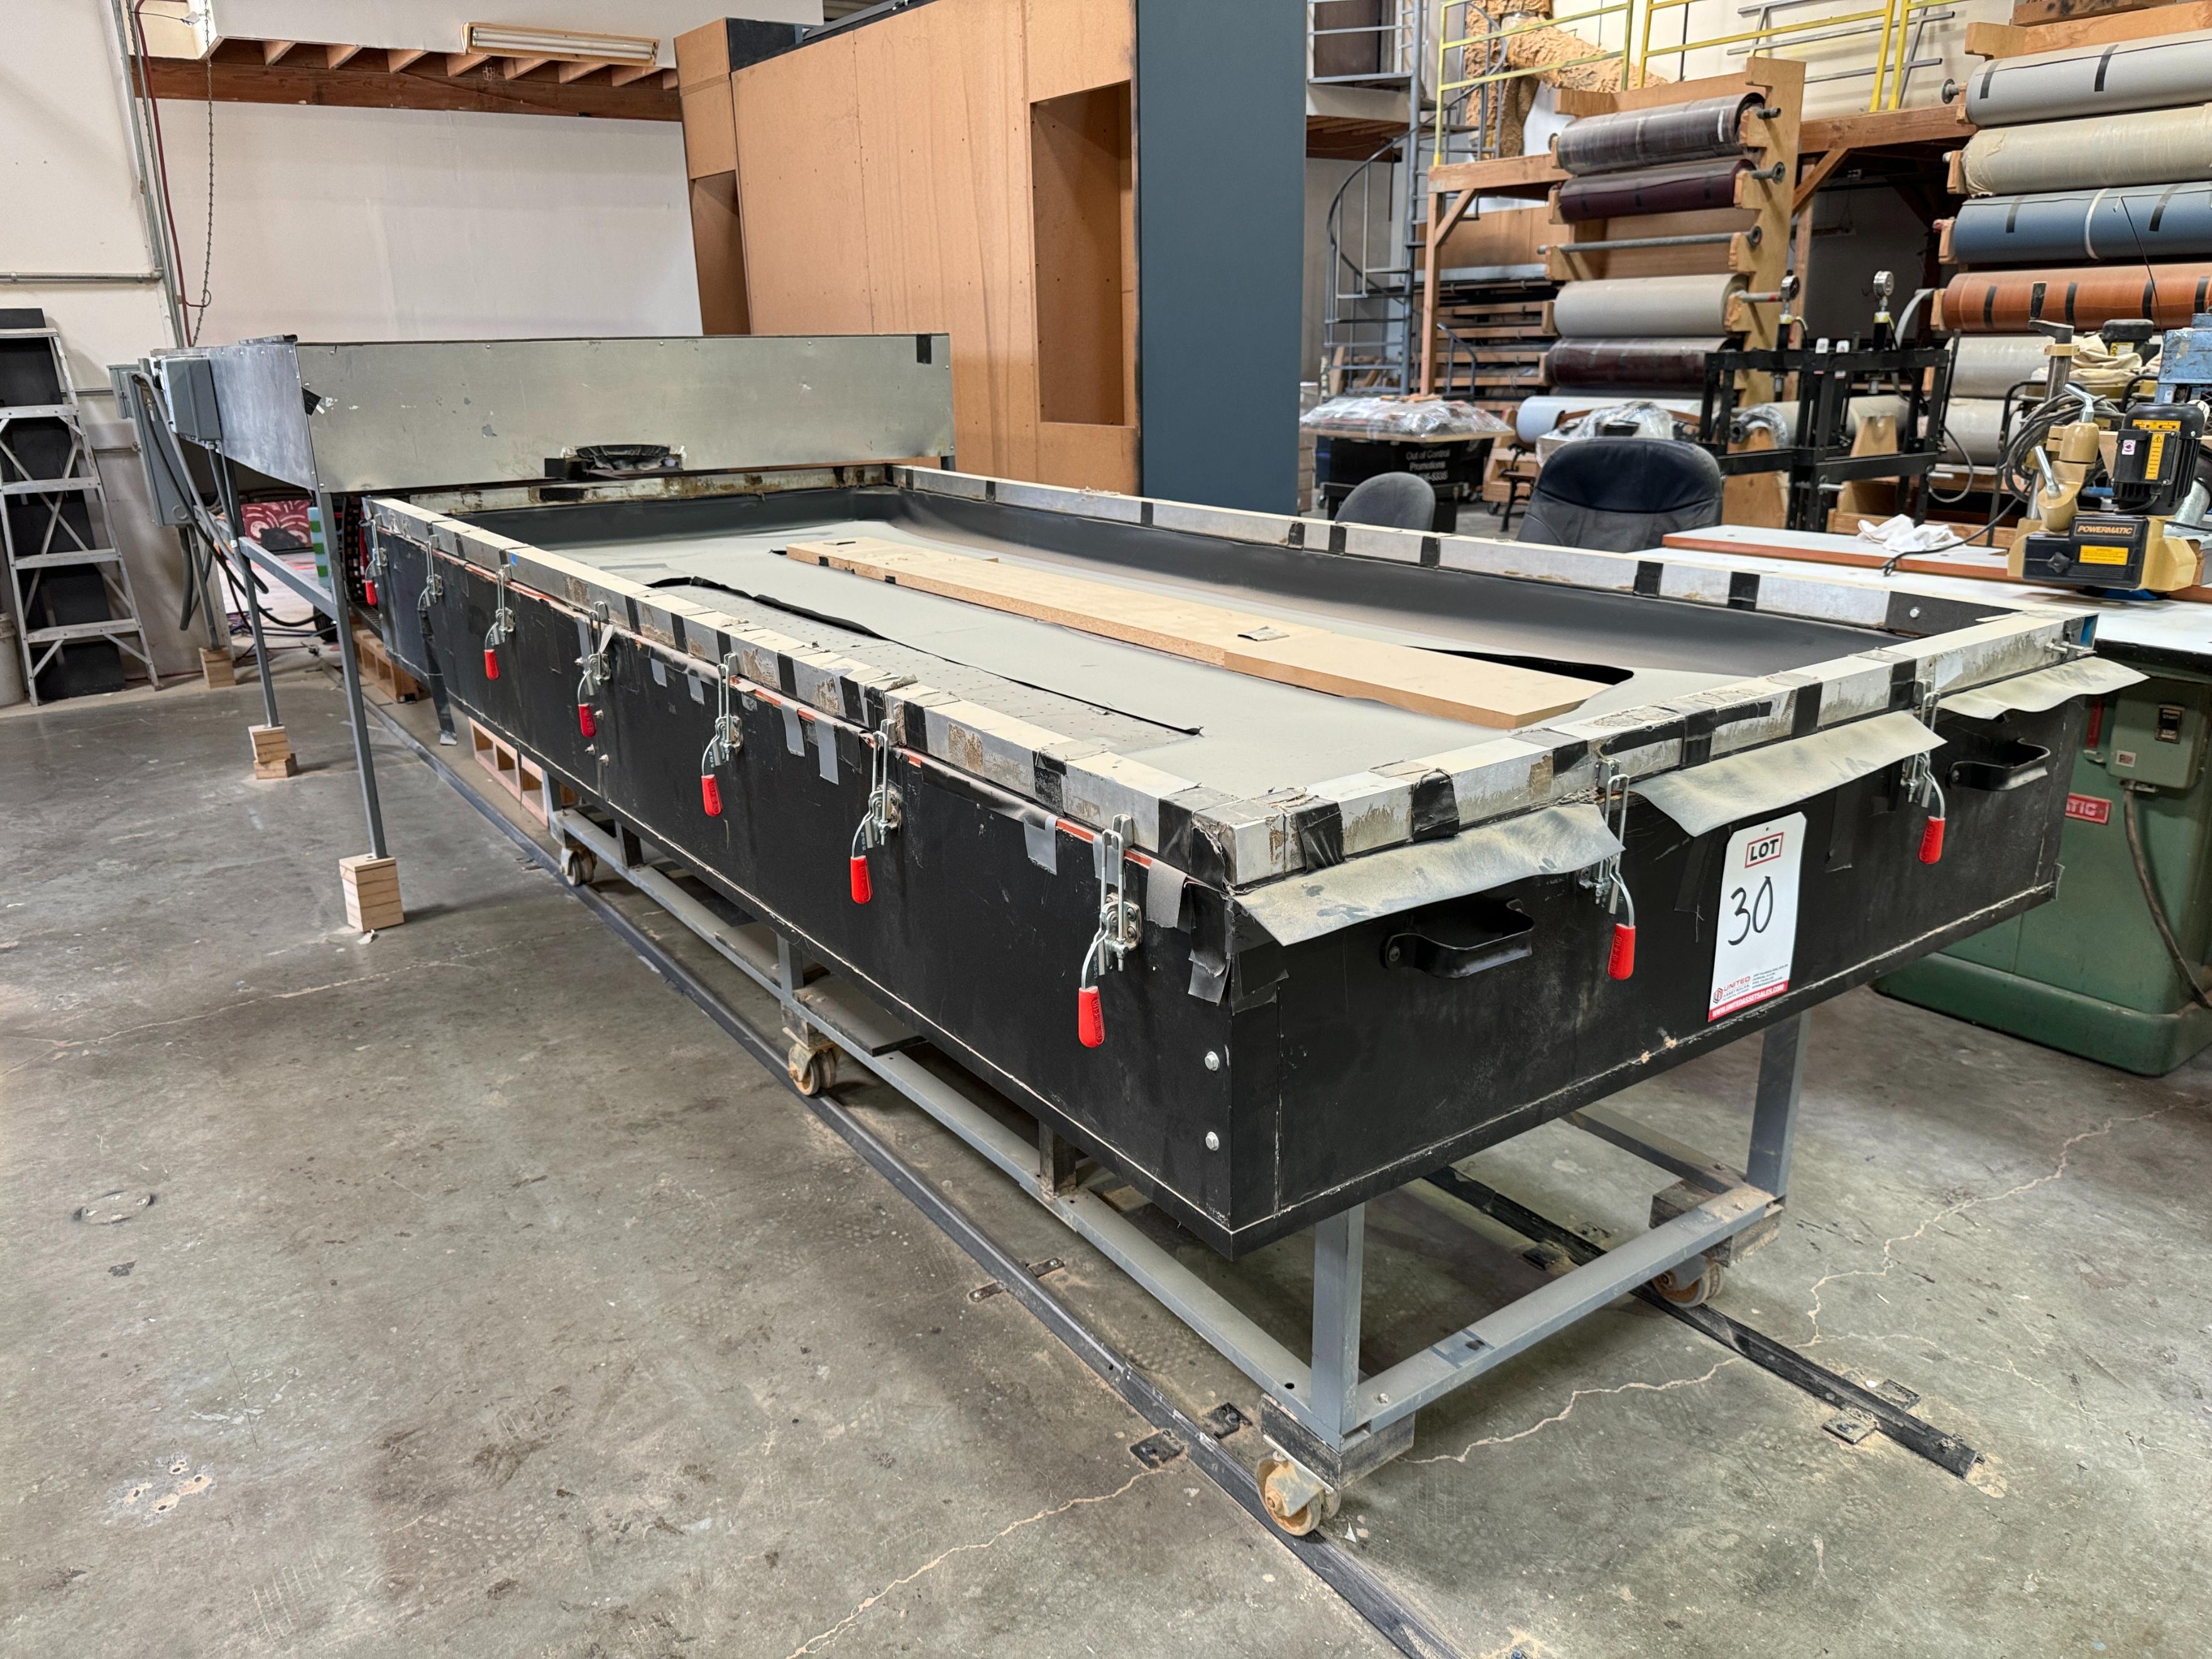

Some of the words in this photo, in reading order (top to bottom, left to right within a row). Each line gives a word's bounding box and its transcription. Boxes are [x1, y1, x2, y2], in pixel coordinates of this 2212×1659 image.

[1406, 451, 1418, 460] Out
[1418, 450, 1426, 459] of
[1427, 448, 1451, 459] Control
[1410, 461, 1446, 471] Promotions
[2078, 525, 2133, 534] POWERMATIC
[1750, 838, 1779, 862] LOT
[1728, 876, 1773, 946] 30
[1724, 976, 1750, 991] UNITED
[1712, 983, 1785, 1017] WWW.UNITEDASSETSALES.COM
